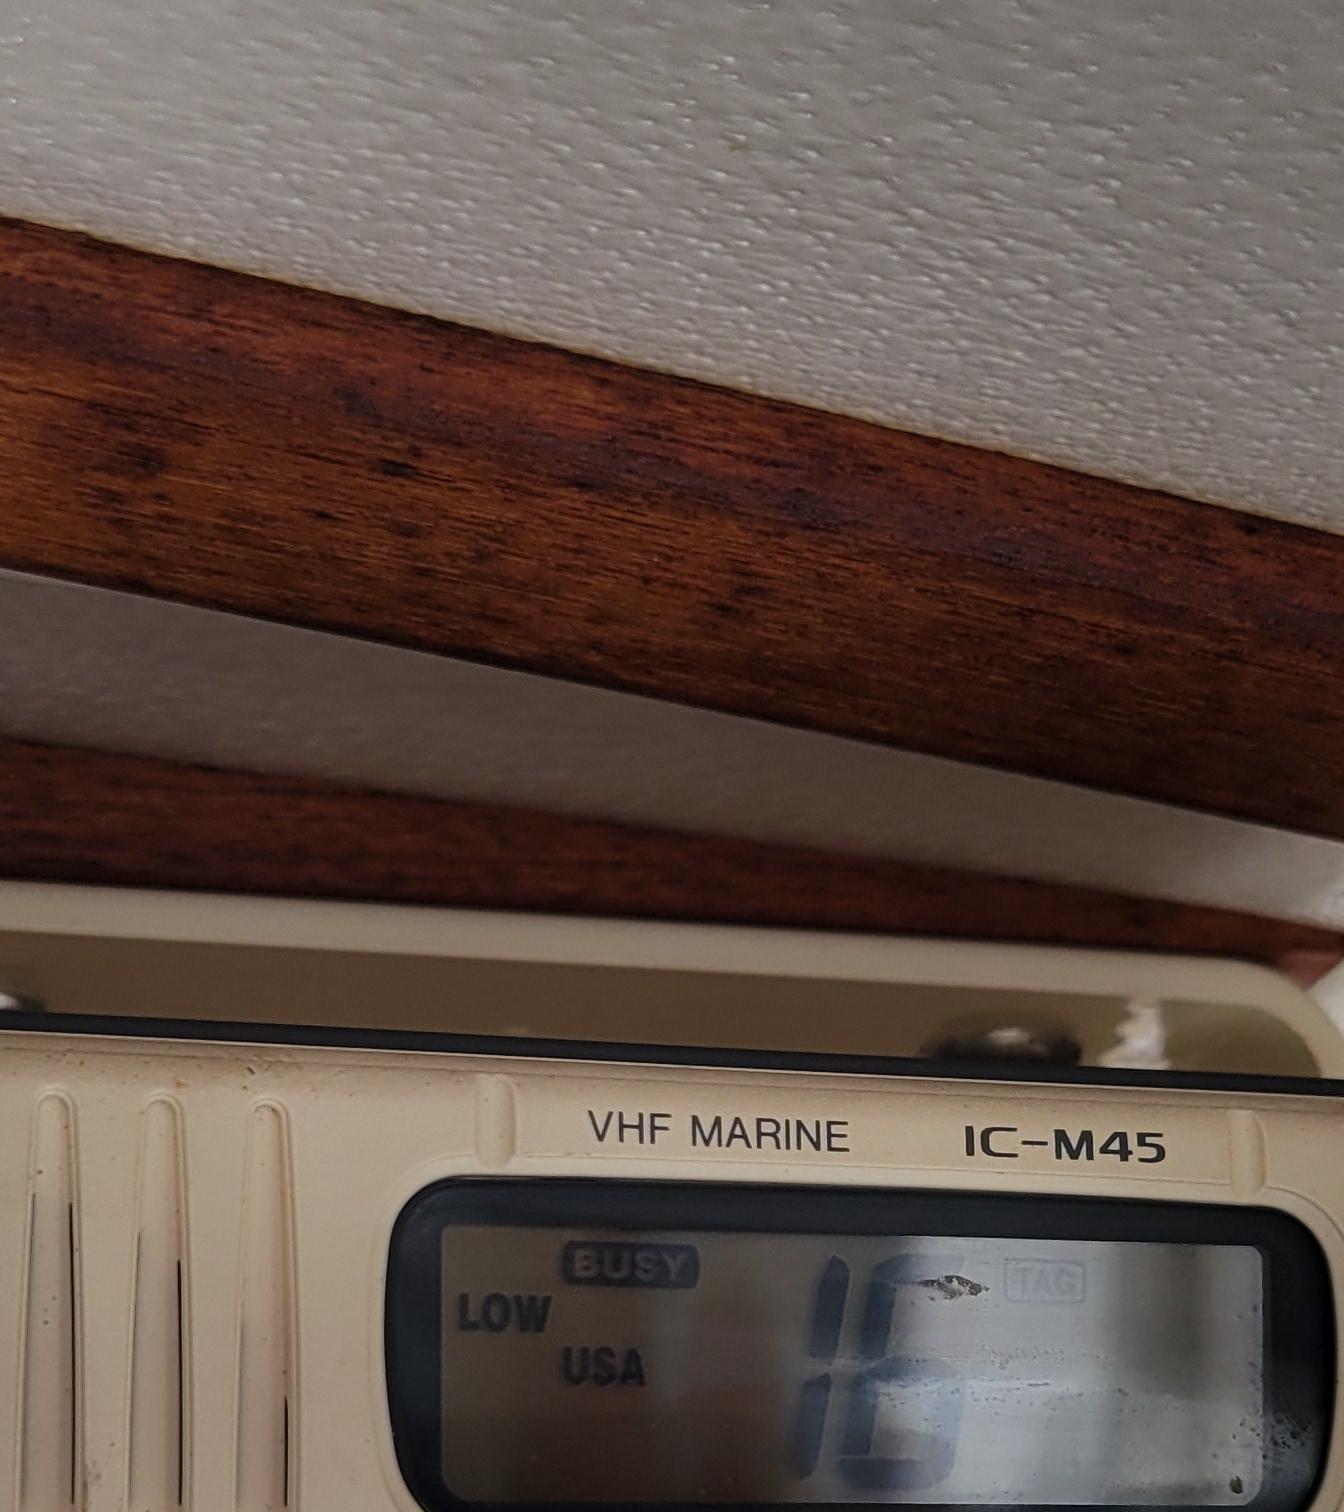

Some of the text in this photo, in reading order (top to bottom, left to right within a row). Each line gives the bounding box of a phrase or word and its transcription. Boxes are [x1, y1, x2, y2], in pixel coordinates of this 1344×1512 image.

[587, 1109, 852, 1154] VHF MARINE
[963, 1124, 1168, 1166] IC-M45
[571, 1248, 689, 1284] BUSY
[1014, 1262, 1080, 1299] TAG
[457, 1292, 551, 1335] LOW
[563, 1347, 648, 1387] USA
[795, 1253, 968, 1492] 16
